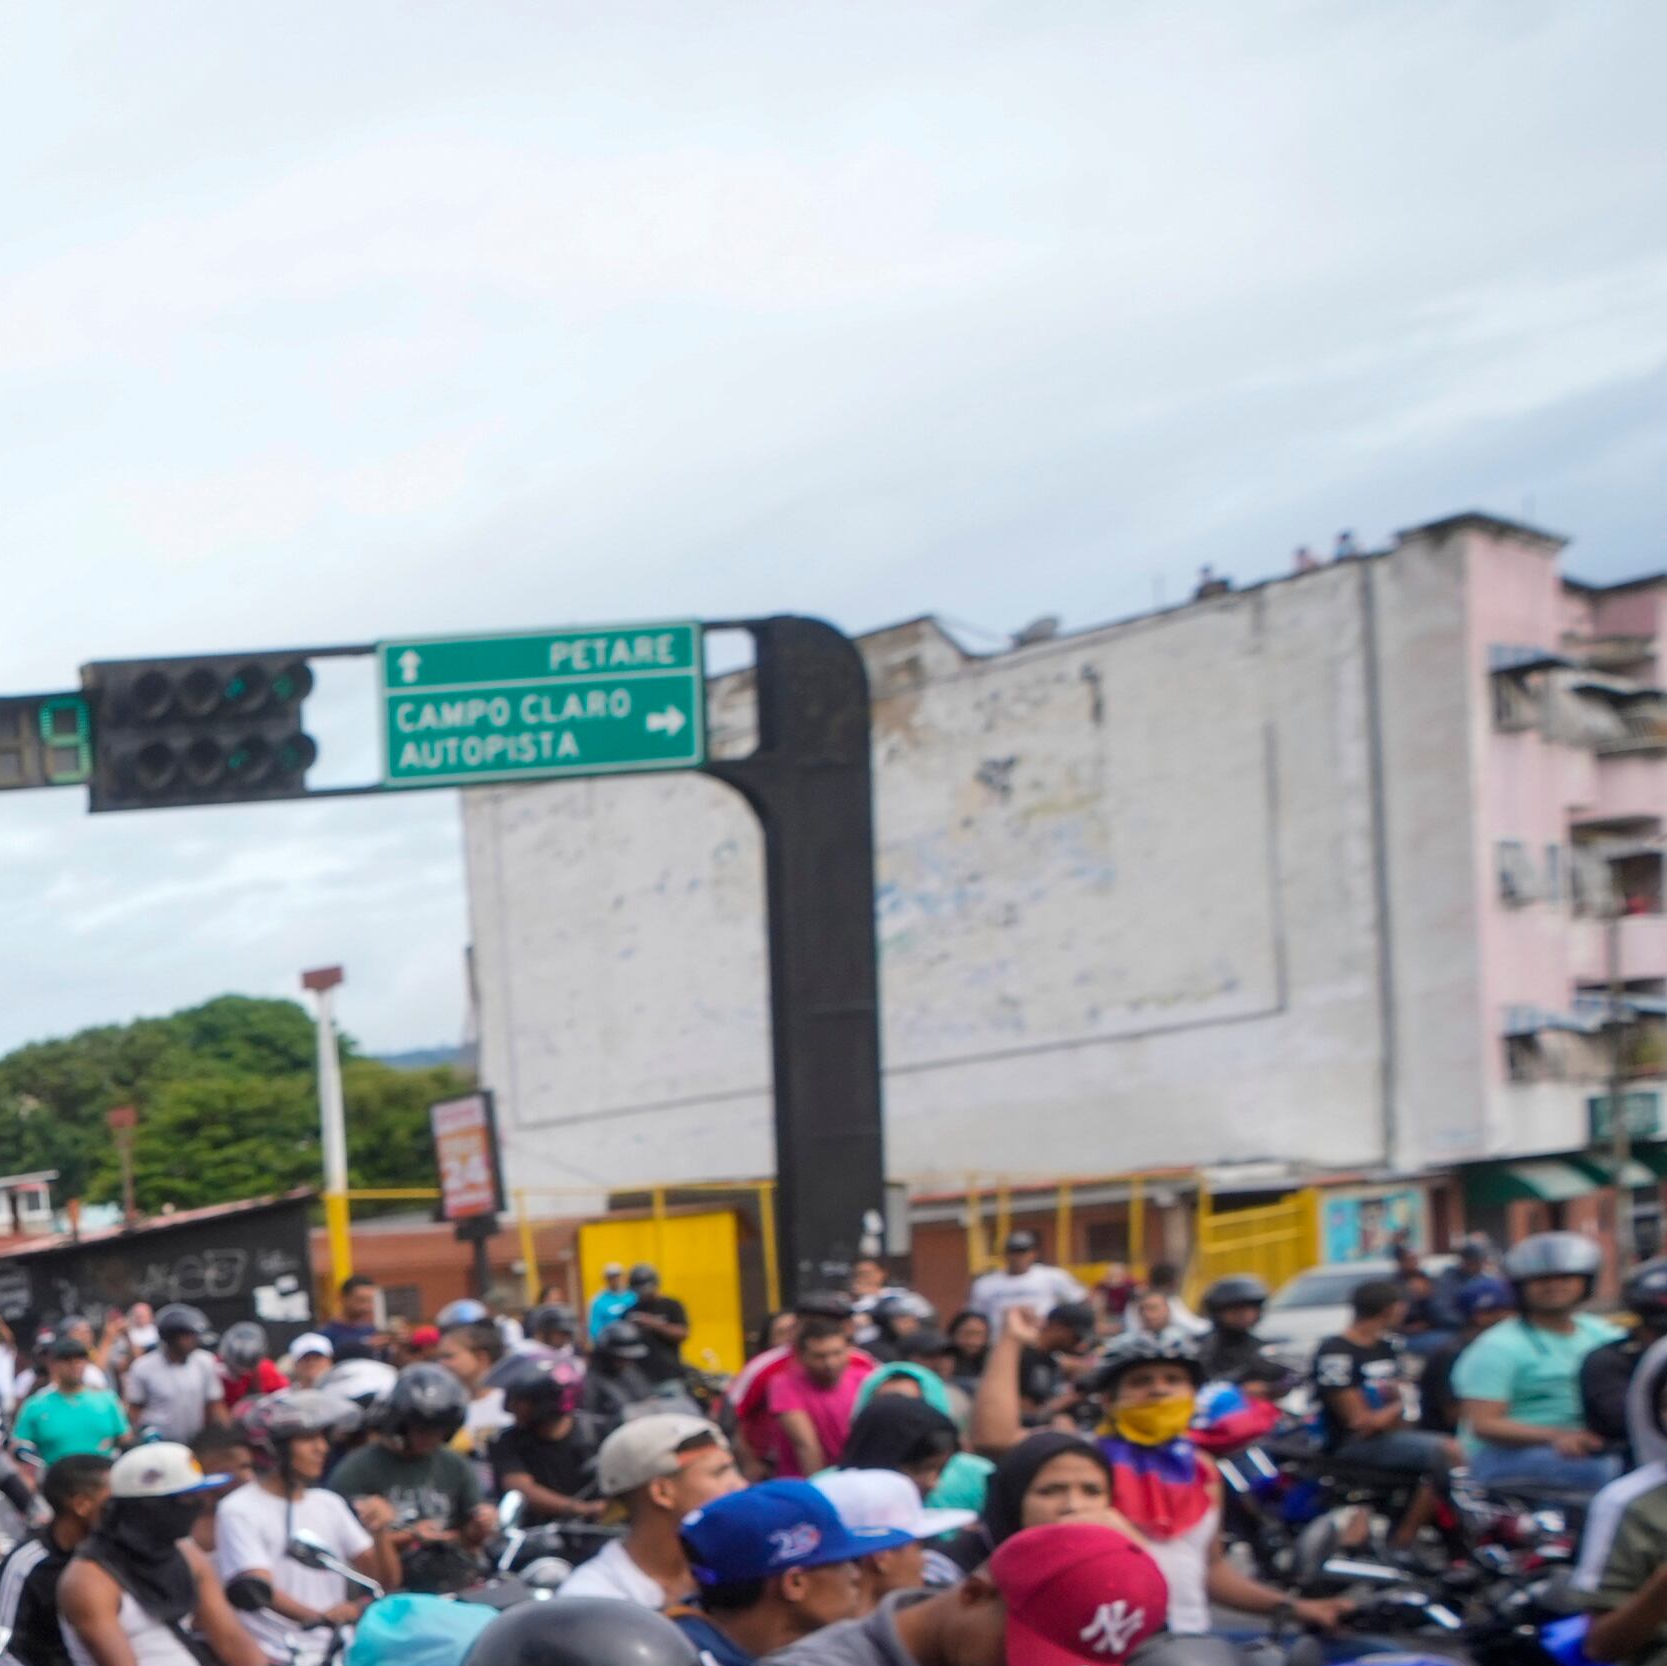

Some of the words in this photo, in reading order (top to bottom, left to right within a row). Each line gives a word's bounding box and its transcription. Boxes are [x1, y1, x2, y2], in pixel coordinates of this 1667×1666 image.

[549, 634, 675, 670] PETARE
[397, 697, 510, 733] CAMPO
[520, 688, 631, 724] CLARO
[398, 731, 580, 768] AUTOPISTA
